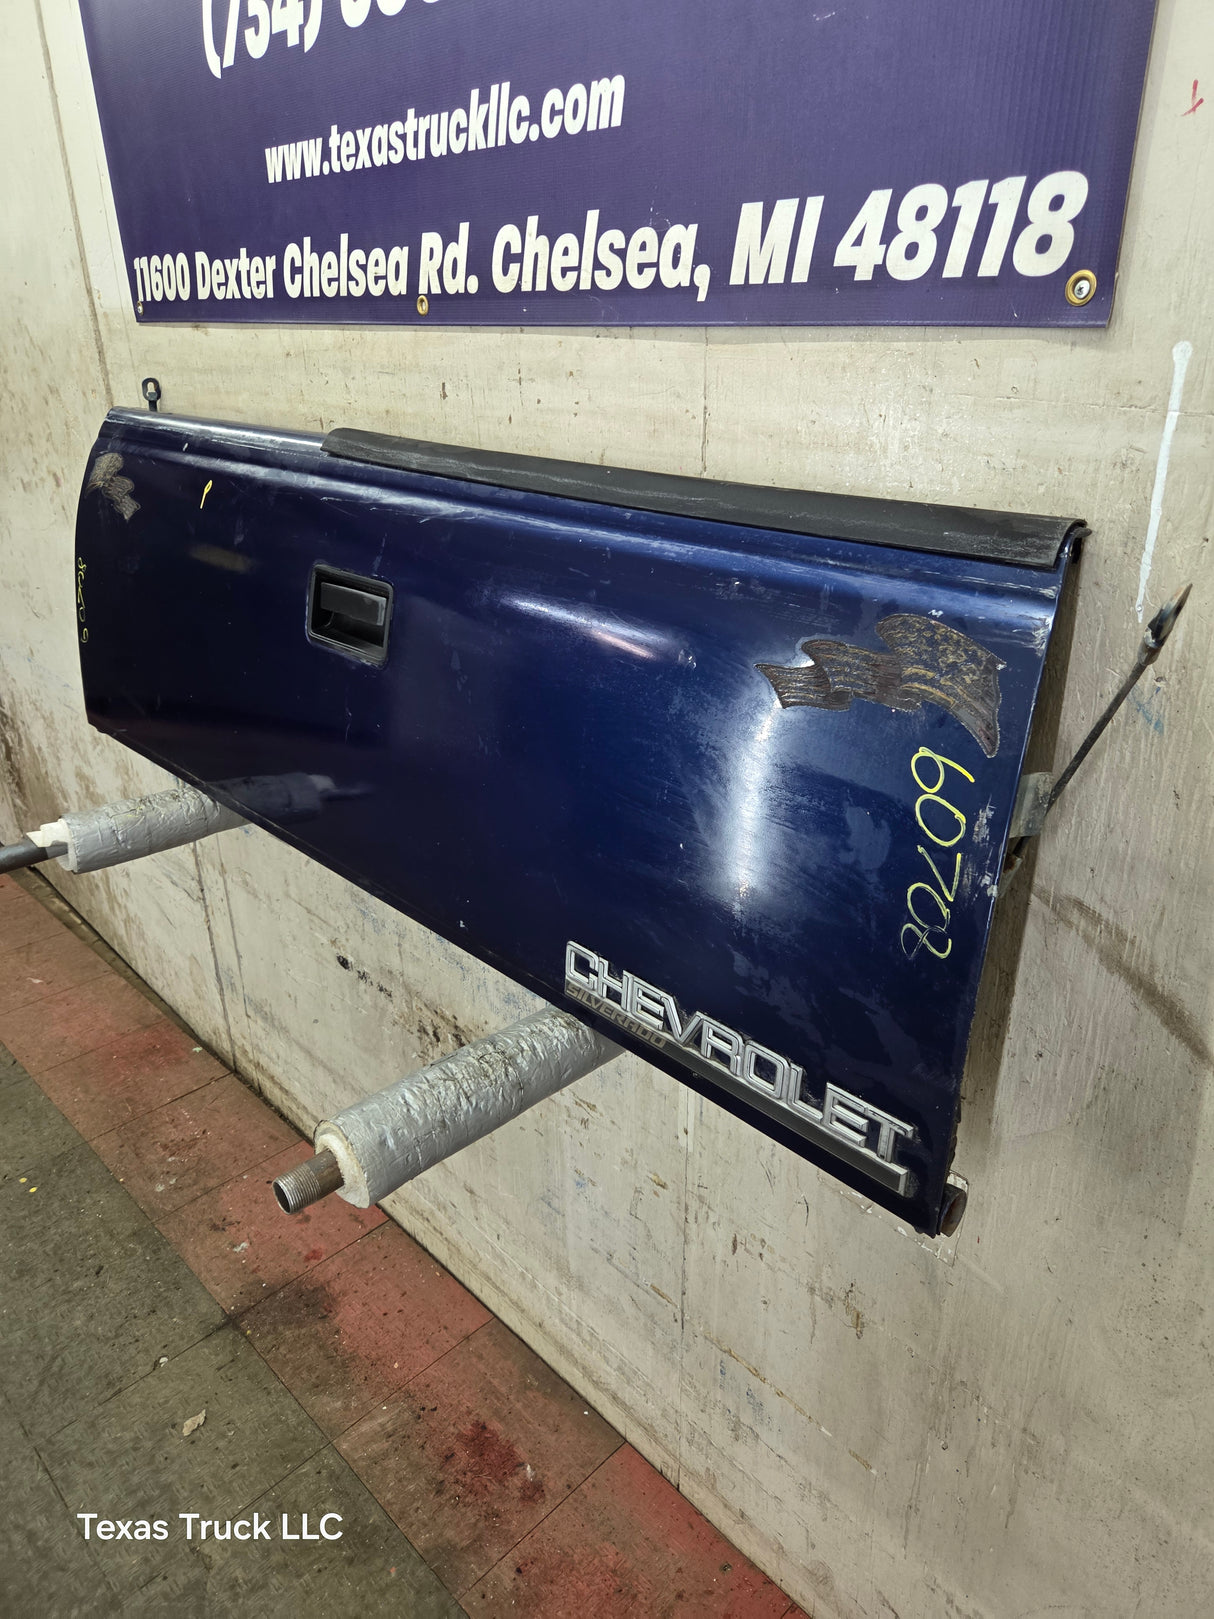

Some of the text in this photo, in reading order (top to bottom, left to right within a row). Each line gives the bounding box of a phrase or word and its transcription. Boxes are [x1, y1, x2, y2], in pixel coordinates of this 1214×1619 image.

[265, 74, 626, 184] www.texastruckllc.com
[134, 170, 1090, 303] 11600 Dexter Chelsea Rd. Chelsea, MI 48118
[900, 746, 975, 960] 60708
[565, 940, 915, 1163] CHEVROLET
[566, 983, 667, 1050] SILVERADO
